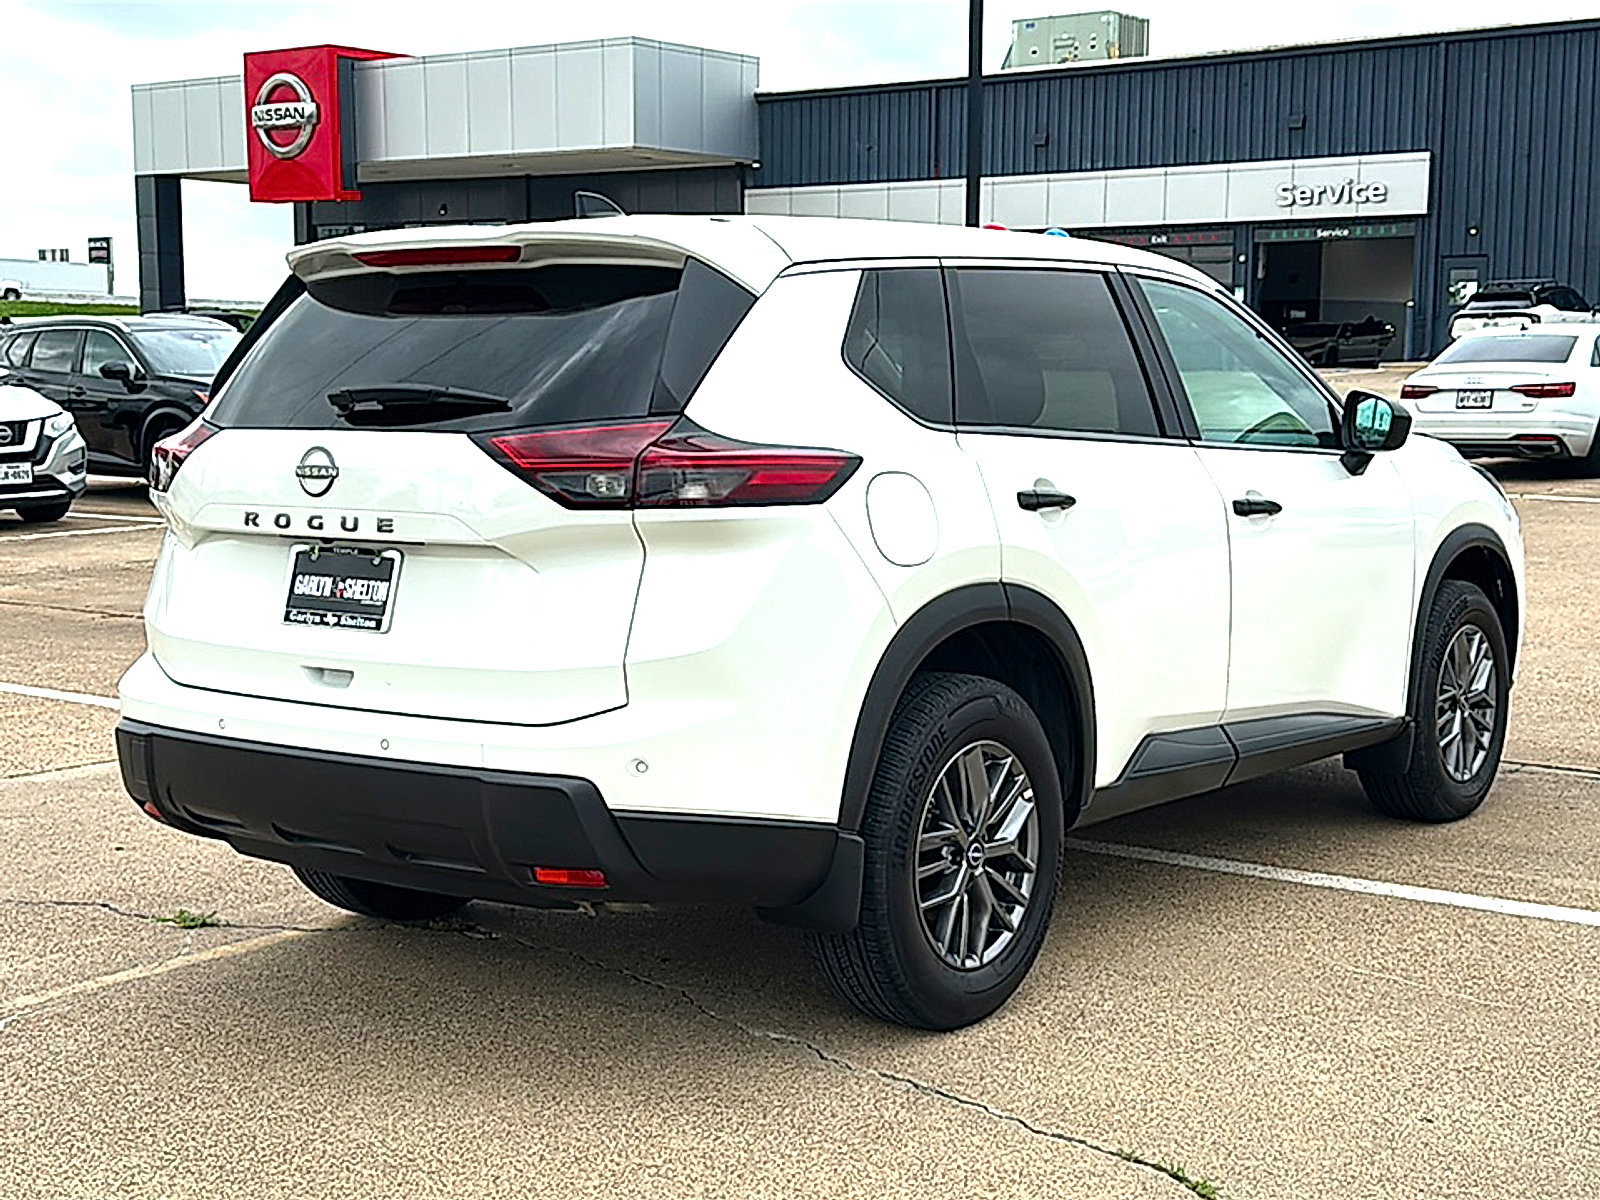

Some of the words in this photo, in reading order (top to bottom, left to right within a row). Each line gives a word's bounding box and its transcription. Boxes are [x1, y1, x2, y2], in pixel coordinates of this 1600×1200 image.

[253, 106, 305, 122] NISSAN
[1276, 178, 1387, 207] Service
[1151, 234, 1168, 244] Exit
[1316, 227, 1350, 238] Service
[297, 466, 338, 477] NISSAN
[244, 511, 395, 534] ROGUE
[343, 577, 391, 602] SHELTON
[288, 611, 321, 625] Garlyn
[339, 614, 377, 628] Shelton
